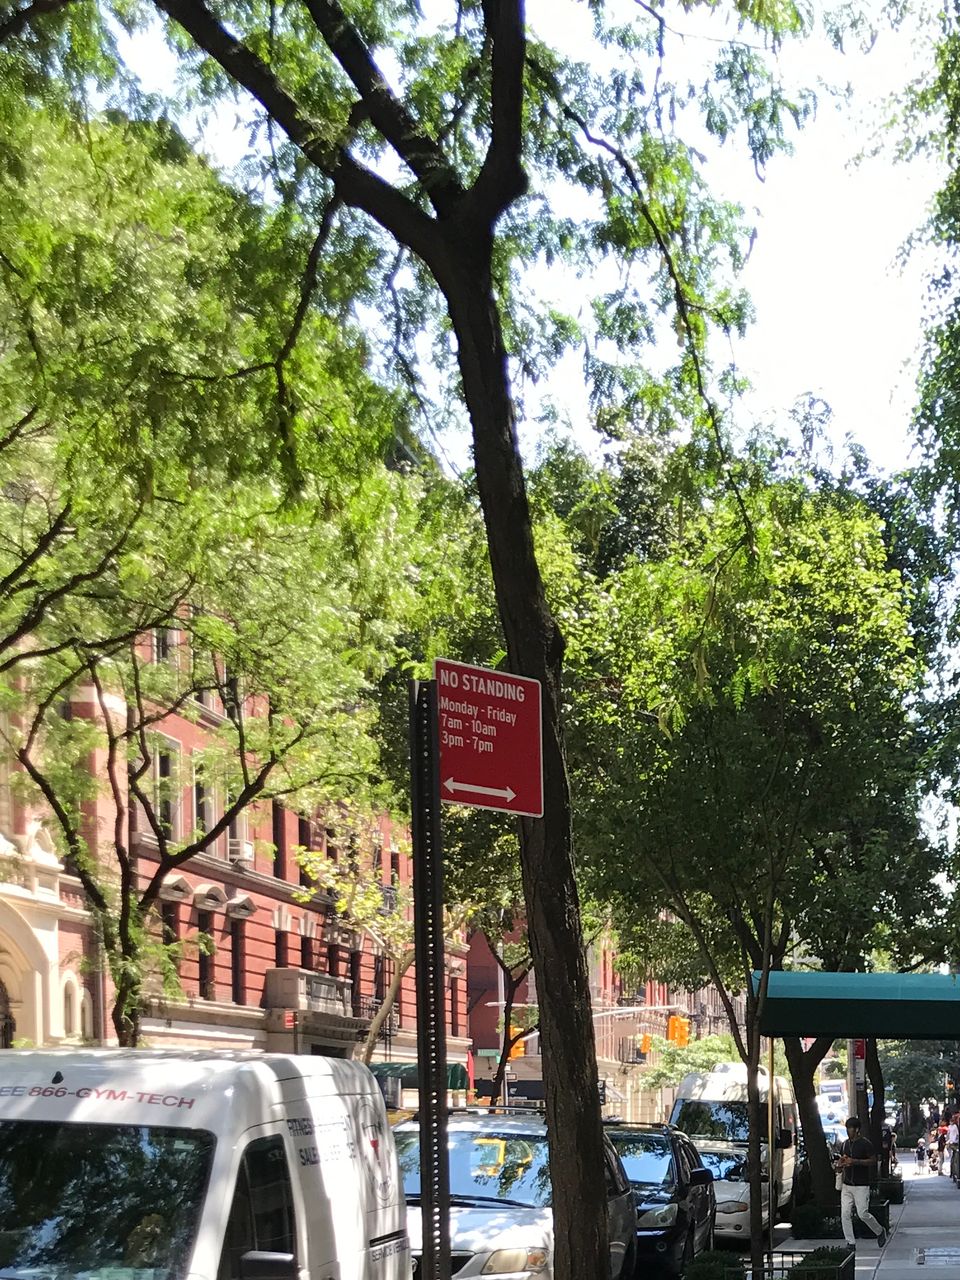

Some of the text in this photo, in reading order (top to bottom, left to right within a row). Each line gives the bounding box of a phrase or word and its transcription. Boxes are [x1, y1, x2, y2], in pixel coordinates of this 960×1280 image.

[440, 669, 525, 702] NO STANDING
[440, 697, 478, 719] Monday
[487, 706, 517, 727] Friday
[442, 714, 463, 730] 7am
[471, 719, 497, 736] 10am
[442, 731, 464, 748] 3pm
[472, 737, 494, 753] 7pm
[28, 1086, 196, 1109] 866-GYM-TECH
